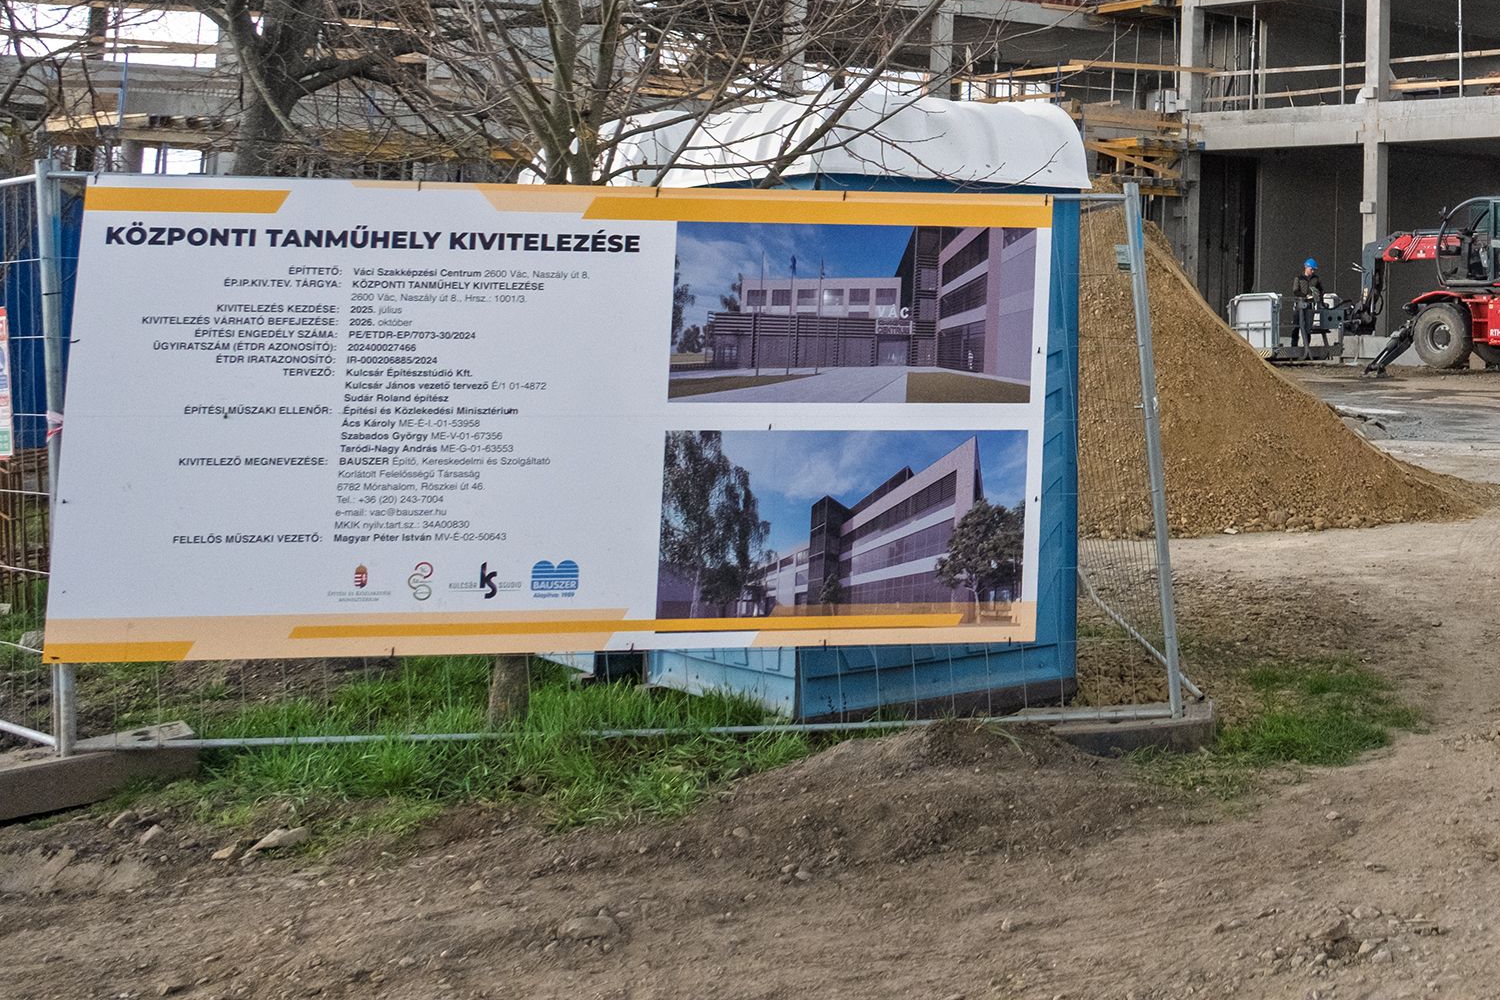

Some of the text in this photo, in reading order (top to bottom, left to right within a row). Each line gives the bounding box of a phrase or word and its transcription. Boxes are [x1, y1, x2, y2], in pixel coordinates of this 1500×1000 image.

[105, 221, 641, 253] KÖZPONTI TANMŰHELY KIVITELEZÉSE
[288, 265, 343, 276] ÉPÍTTETŐ:
[353, 267, 375, 277] Váci
[377, 267, 438, 280] Szakképzési
[440, 269, 482, 278] Centrum
[484, 269, 508, 279] 2600
[533, 270, 569, 282] Naszály
[570, 270, 580, 280] út
[224, 278, 342, 289] ÉP.IP.KIV.TEV. TÁRGYA:
[352, 280, 545, 291] KÖZPONTI TANMŰHELY KIVITELEZÉSE
[351, 292, 374, 302] 2600
[400, 293, 437, 304] Naszály
[439, 294, 448, 302] út
[216, 303, 340, 314] KIVITELEZÉS KEZDÉSE:
[350, 305, 402, 316] 2025. július
[142, 315, 338, 326] KIVITELEZÉS VÁRHATÓ BEFEJEZÉSE:
[349, 318, 413, 327] 2026. október
[194, 328, 338, 339] ÉPÍTÉSI ENGEDÉLY SZÁMA:
[153, 340, 337, 352] ÜGYIRATSZÁM (ÉTDR AZONOSÍTÓ):
[216, 354, 336, 364] ÉTDR IRATAZONOSÍTÓ:
[283, 367, 335, 377] TERVEZŐ:
[346, 367, 473, 379] Kulcsár Építészstúdió Kft.
[345, 381, 383, 390] Kulcsár
[385, 381, 415, 390] János
[419, 381, 450, 390] vezető
[453, 381, 488, 390] tervező
[344, 393, 449, 404] Sudár Roland építész
[184, 404, 333, 415] ÉPÍTÉSI MŰSZAKI ELLENŐR:
[343, 406, 518, 417] Építési és Közlekedési Minisztérium
[341, 417, 361, 428] Ács
[364, 418, 395, 430] Károly
[341, 431, 389, 441] Szabados
[392, 432, 428, 443] György
[340, 444, 400, 455] Taródi-Nagy
[402, 444, 438, 453] András
[178, 456, 328, 466] KIVITELEZŐ MEGNEVEZÉSE:
[339, 457, 389, 466] BAUSZER
[422, 457, 484, 466] Kereskedelmi
[487, 457, 498, 466] és
[500, 456, 551, 467] Szolgáltató
[338, 470, 376, 479] Korlátolt
[438, 469, 480, 480] Társaság
[336, 482, 360, 491] 6782
[460, 482, 469, 491] út
[358, 495, 376, 504] +36
[379, 495, 398, 505] (20)
[335, 508, 447, 517] e-mail: vac@bauszer.hu
[334, 520, 360, 529] MKIK
[172, 532, 323, 544] FELELŐS MŰSZAKI VEZETŐ:
[334, 534, 370, 544] Magyar
[373, 533, 398, 542] Péter
[402, 533, 432, 542] István
[532, 580, 577, 590] BAUSZER
